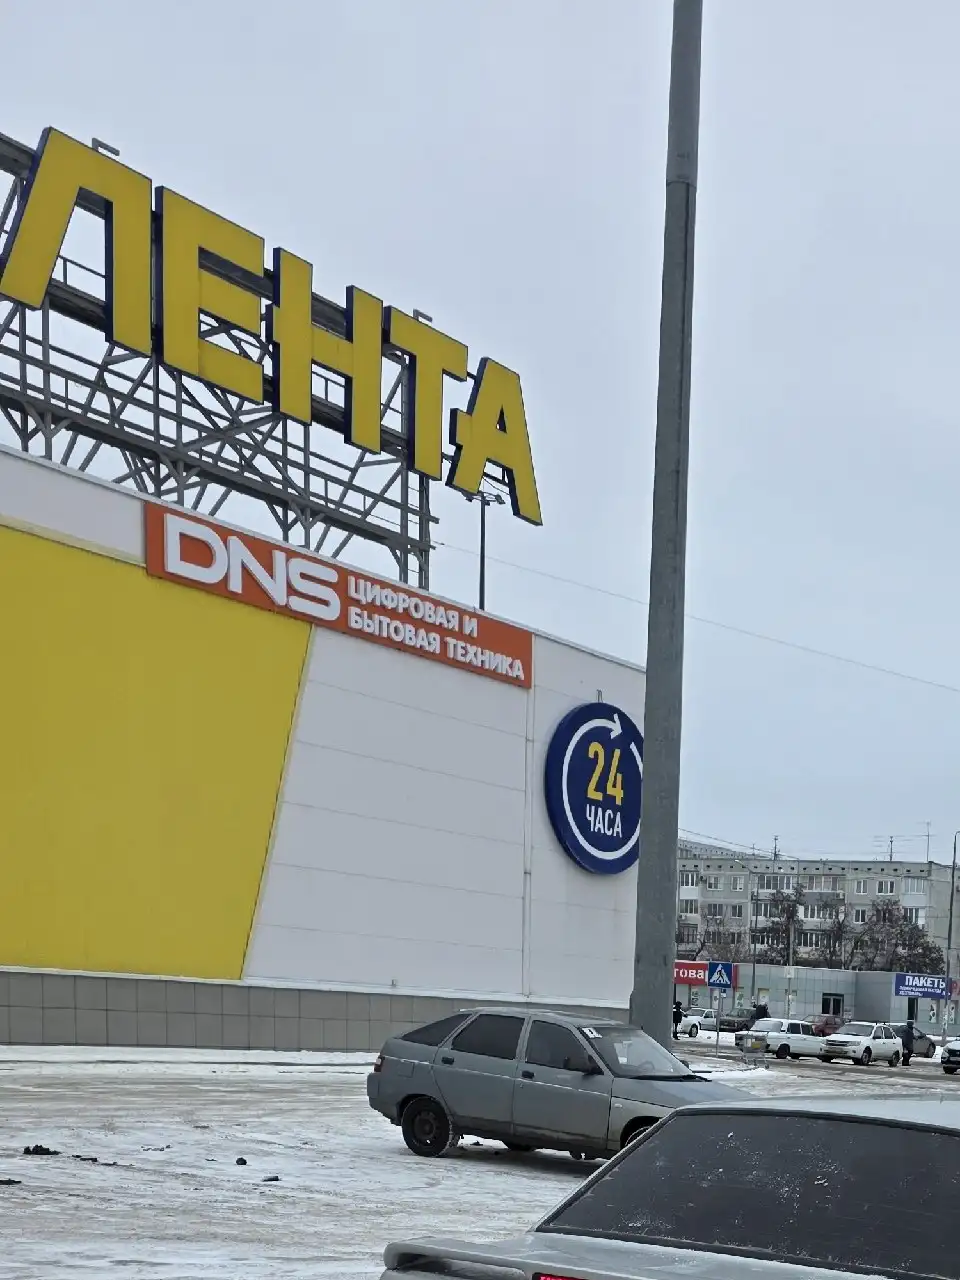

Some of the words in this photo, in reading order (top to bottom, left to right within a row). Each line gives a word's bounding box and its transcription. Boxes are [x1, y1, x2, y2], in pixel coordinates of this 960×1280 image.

[0, 126, 543, 526] ЛЕНТА
[164, 513, 340, 621] DNS
[348, 575, 459, 631] ЦИФРОВАЯ
[463, 615, 478, 638] И
[348, 606, 440, 654] БЫТОВАЯ
[444, 636, 525, 680] ТЕХНИКА
[587, 741, 624, 806] 24
[586, 803, 623, 838] ЧАСА
